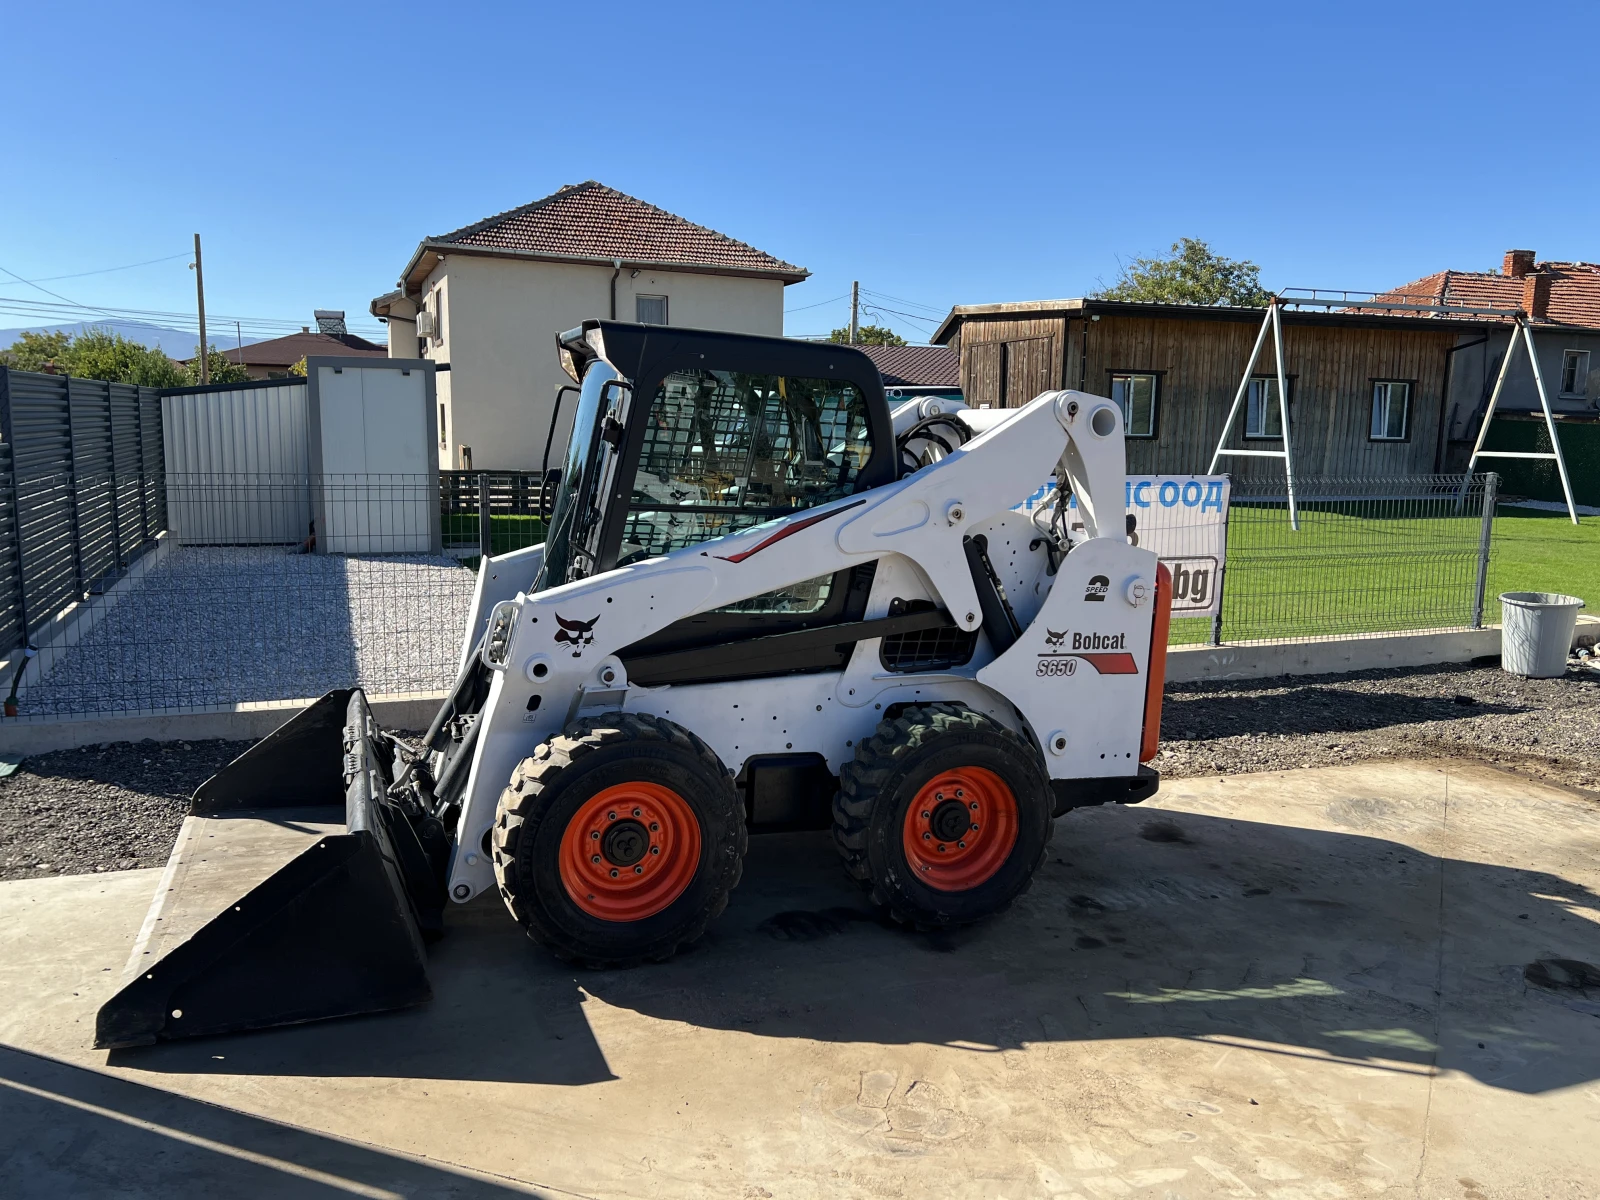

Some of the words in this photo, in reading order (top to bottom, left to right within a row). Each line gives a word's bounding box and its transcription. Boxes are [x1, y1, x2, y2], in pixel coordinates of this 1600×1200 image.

[1159, 481, 1223, 513] ООД
[1084, 575, 1110, 602] 2
[1172, 563, 1209, 604] bg
[1072, 632, 1125, 650] Bobcat
[1036, 659, 1077, 677] S650
